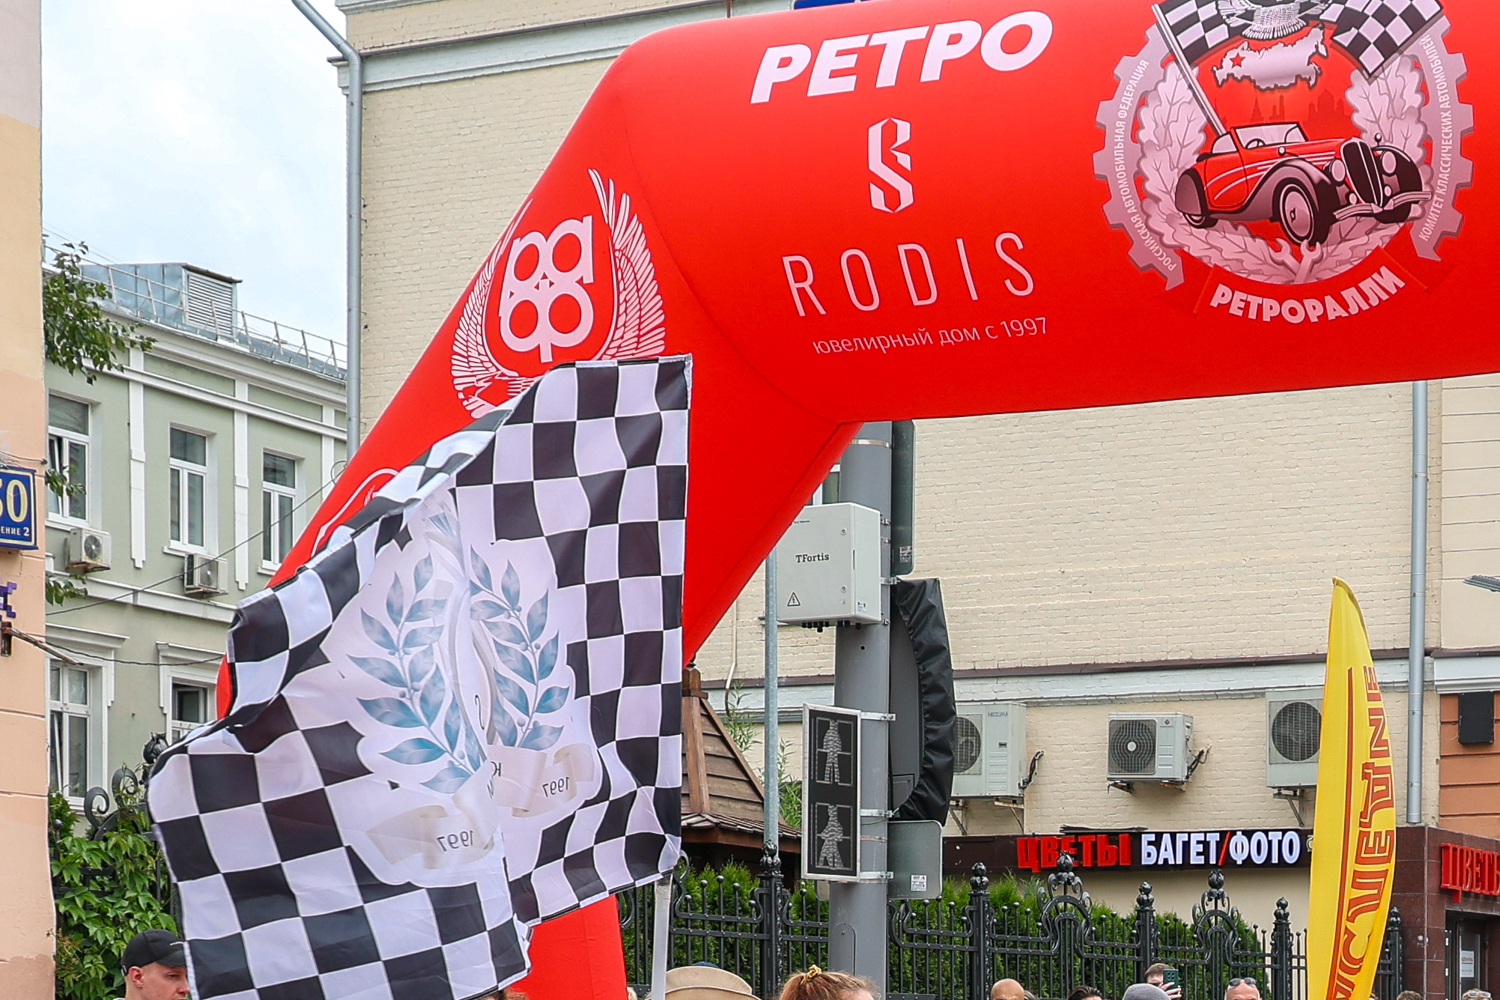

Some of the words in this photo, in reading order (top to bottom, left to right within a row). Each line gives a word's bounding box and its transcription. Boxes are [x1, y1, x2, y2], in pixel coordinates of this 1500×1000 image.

[750, 10, 1054, 104] РЕТРО
[1418, 34, 1452, 111] АВТОМОБИЛЕЙ
[1117, 59, 1150, 119] ФЕДЕРАЦИЯ
[1113, 120, 1142, 214] АВТОМОБИЛЬНАЯ
[1436, 112, 1453, 195] КЛАССИЧЕСКИХ
[1130, 215, 1177, 272] РОССИЙСКАЯ
[1418, 195, 1445, 242] КОМИТЕТ
[781, 231, 1036, 317] RODIS
[1208, 264, 1406, 325] РЕТРОРАЛЛИ
[812, 326, 933, 355] ювелирный
[940, 326, 981, 347] дом
[1000, 315, 1049, 341] 1997
[0, 478, 28, 522] 0
[1, 526, 21, 536] ЕНИЕ
[795, 552, 830, 563] TFortis
[1016, 833, 1131, 873] ЦВЕТЫ
[1141, 831, 1300, 866] БАГЕТ/ФОТО
